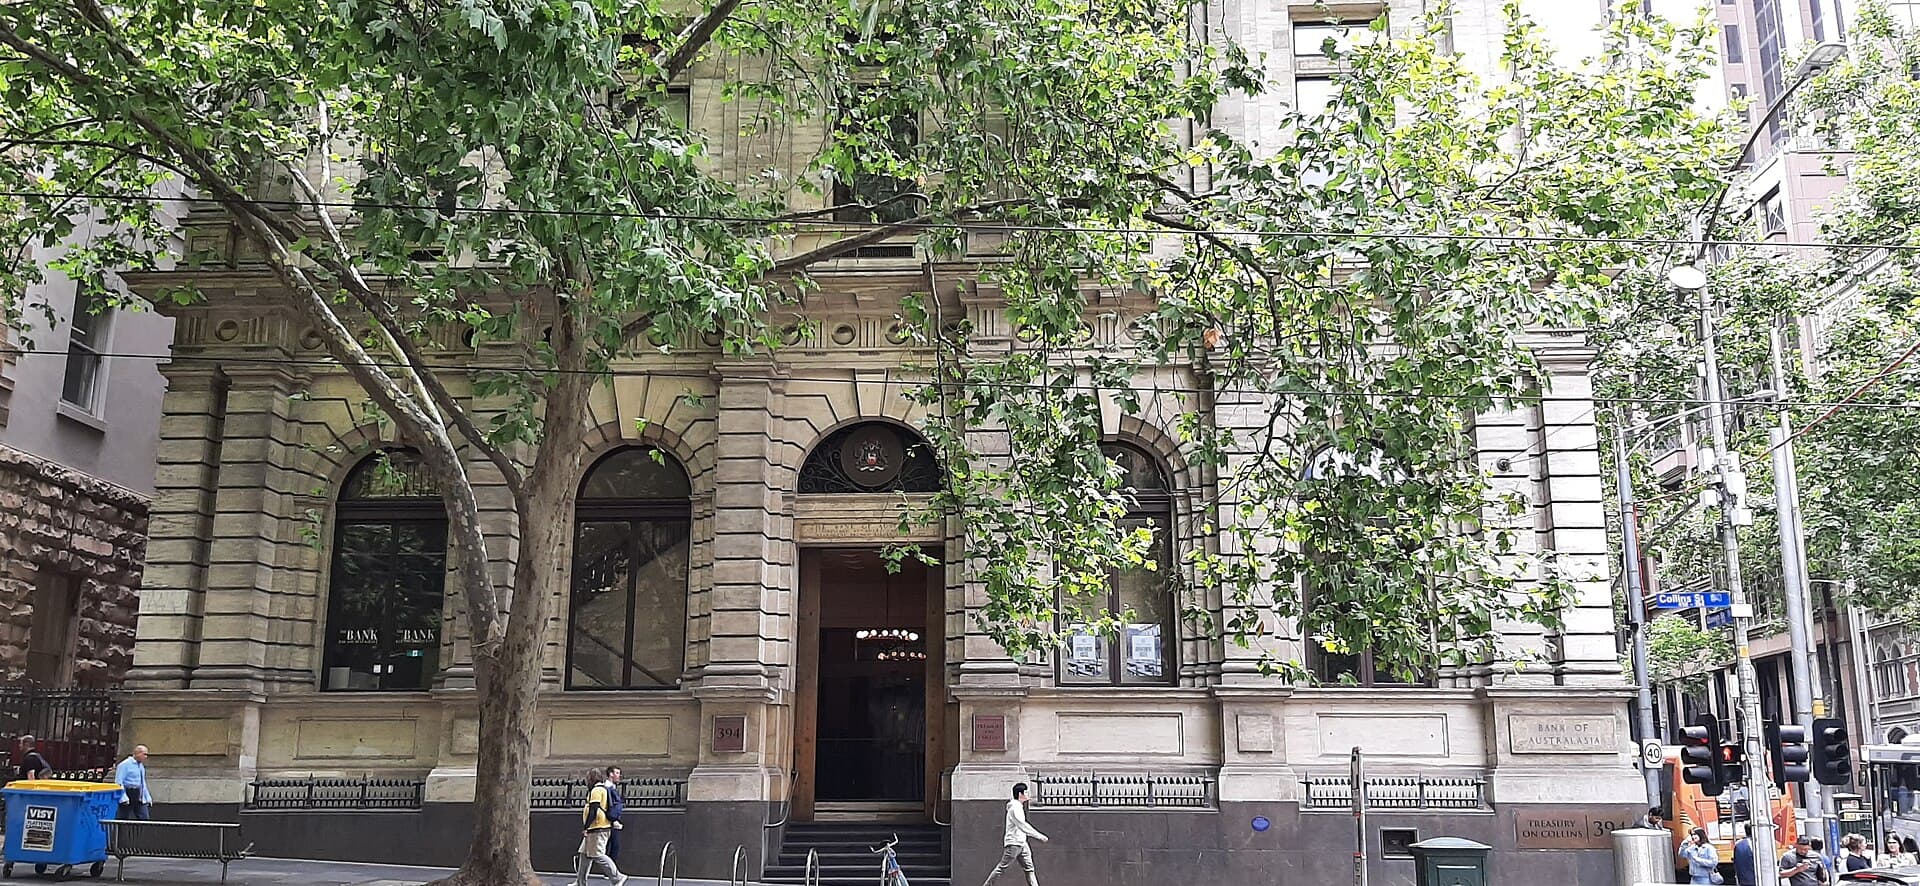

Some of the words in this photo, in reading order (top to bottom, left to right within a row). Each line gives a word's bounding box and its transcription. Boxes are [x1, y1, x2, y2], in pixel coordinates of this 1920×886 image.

[1659, 593, 1691, 603] Collins
[1694, 593, 1705, 602] St
[346, 629, 378, 641] BANK
[403, 629, 435, 640] BANK
[717, 727, 740, 739] 394
[1537, 723, 1566, 732] BANK
[1574, 723, 1589, 732] OF
[1528, 736, 1600, 745] AUSTRALASIA
[1647, 748, 1660, 759] 40
[29, 808, 54, 819] VISY
[1528, 819, 1576, 828] TREASURY
[1593, 820, 1625, 837] 39
[1522, 830, 1538, 838] ON
[1541, 830, 1583, 838] COLLINS
